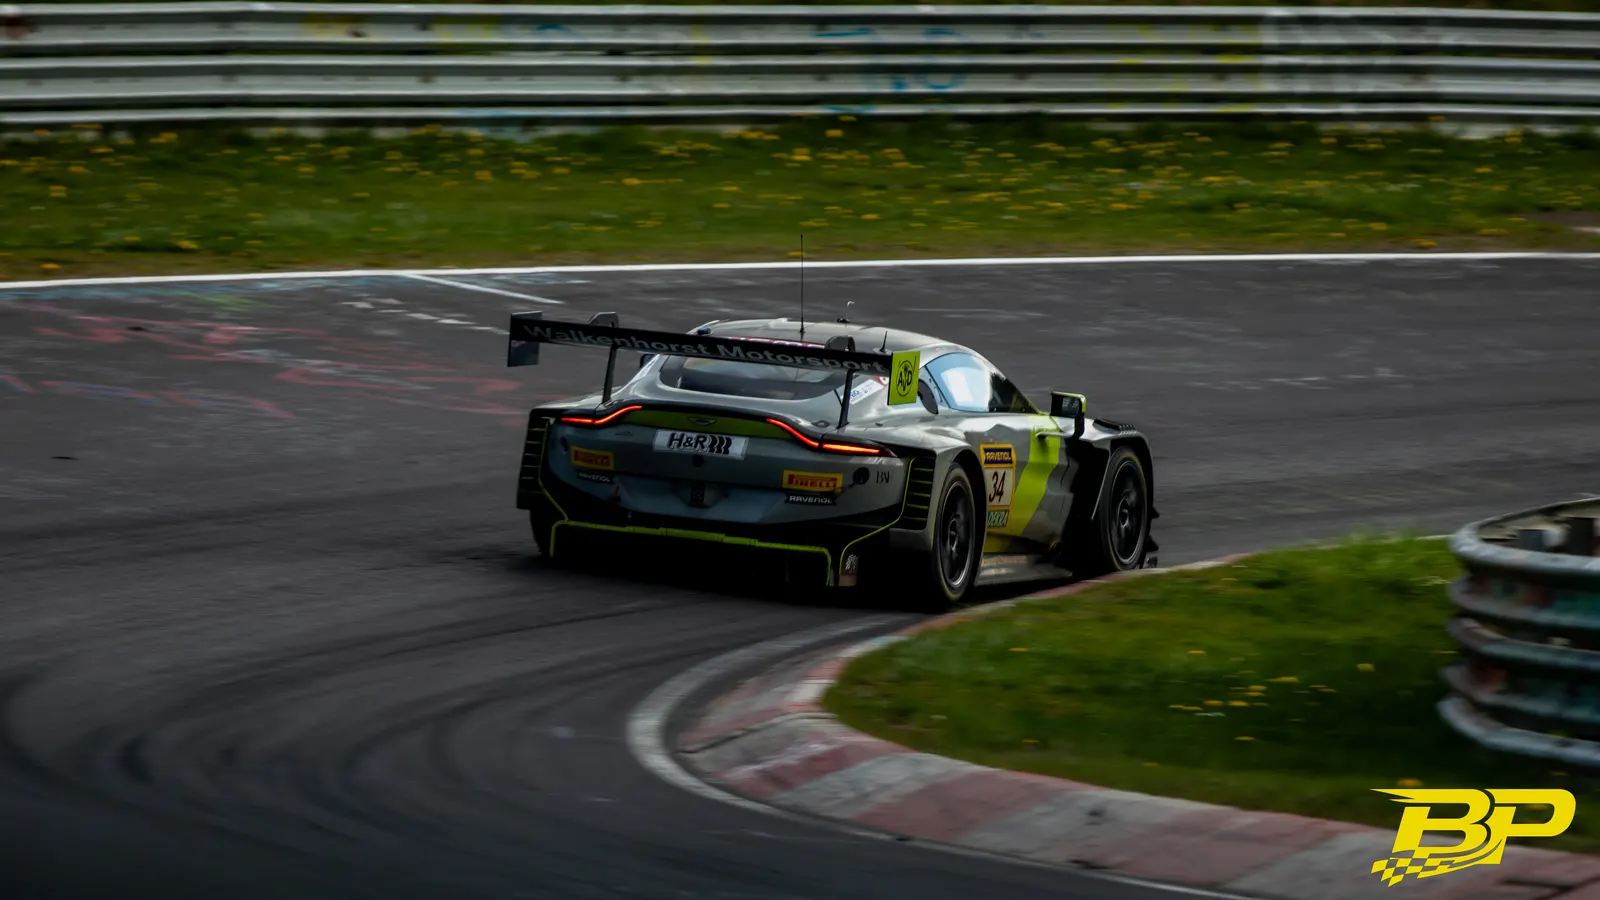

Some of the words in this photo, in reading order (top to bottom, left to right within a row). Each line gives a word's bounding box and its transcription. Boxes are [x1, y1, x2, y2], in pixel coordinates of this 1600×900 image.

[522, 325, 709, 355] Walkenhorst
[716, 344, 887, 373] Motorsport
[668, 432, 707, 450] H&R
[985, 451, 1011, 460] RAVENOL
[787, 474, 838, 488] PIRELLI
[988, 471, 1006, 502] 34
[789, 495, 833, 504] RAVENOL
